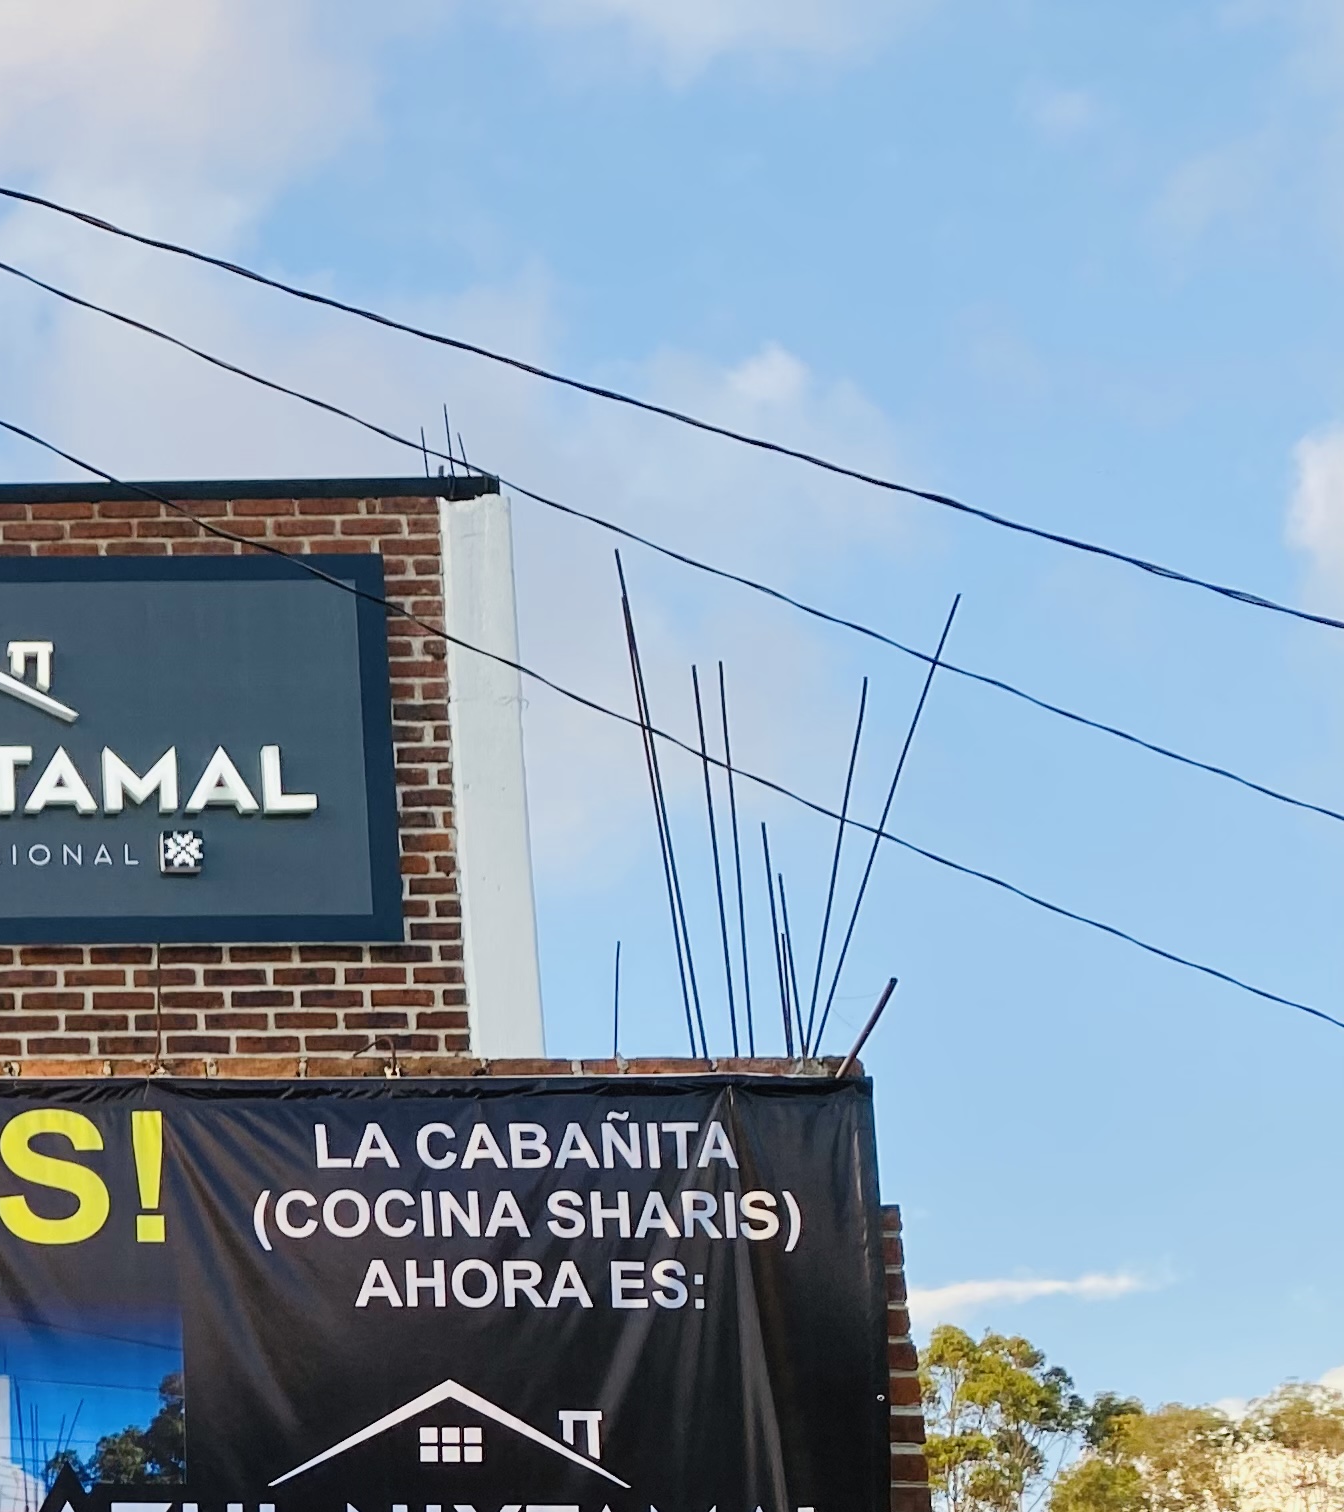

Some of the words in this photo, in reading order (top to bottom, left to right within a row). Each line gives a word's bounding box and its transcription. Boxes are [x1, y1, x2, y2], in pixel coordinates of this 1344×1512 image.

[314, 1122, 400, 1170] LA
[416, 1112, 738, 1170] CABAÑITA
[253, 1189, 534, 1253] (COCINA
[546, 1189, 802, 1253] SHARIS)
[354, 1260, 593, 1308] AHORA
[610, 1261, 707, 1310] ES:
